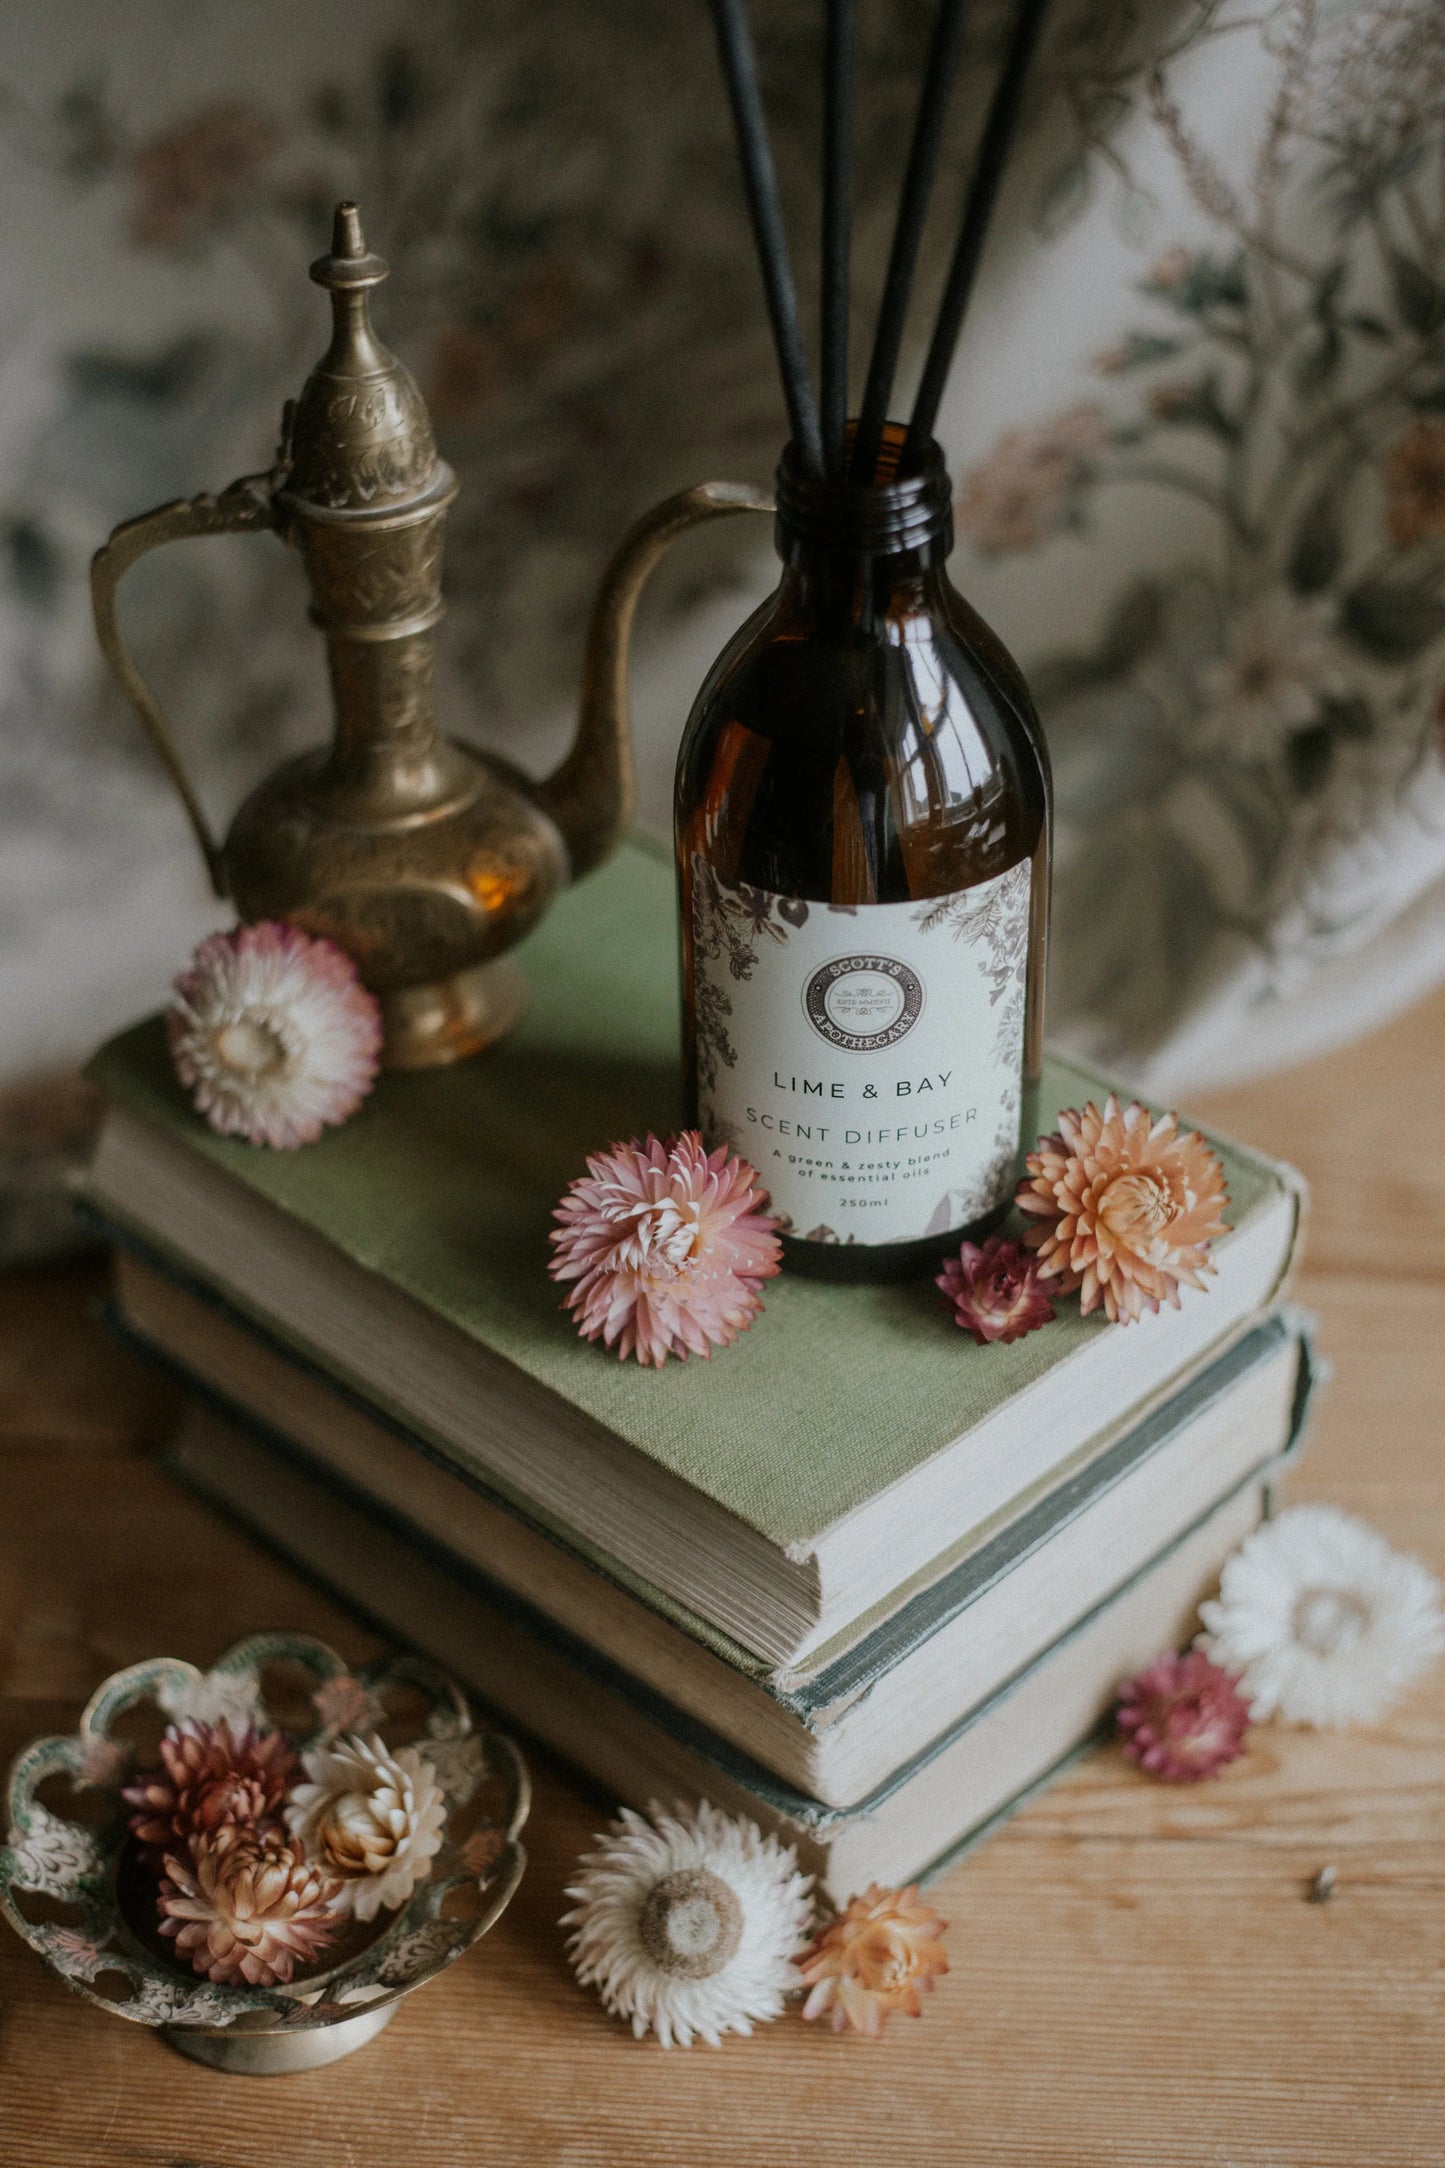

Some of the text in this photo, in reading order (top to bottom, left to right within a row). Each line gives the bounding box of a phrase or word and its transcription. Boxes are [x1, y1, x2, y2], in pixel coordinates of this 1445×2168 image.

[829, 957, 902, 977] SCOTT'S
[813, 1012, 915, 1048] APOTHECARY
[774, 1071, 952, 1099] LIME & BAY
[746, 1107, 977, 1144] SCENT DIFFUSER
[772, 1148, 950, 1171] A green & zesty blend
[798, 1166, 930, 1182] of essential oils
[840, 1198, 888, 1208] 250ml
